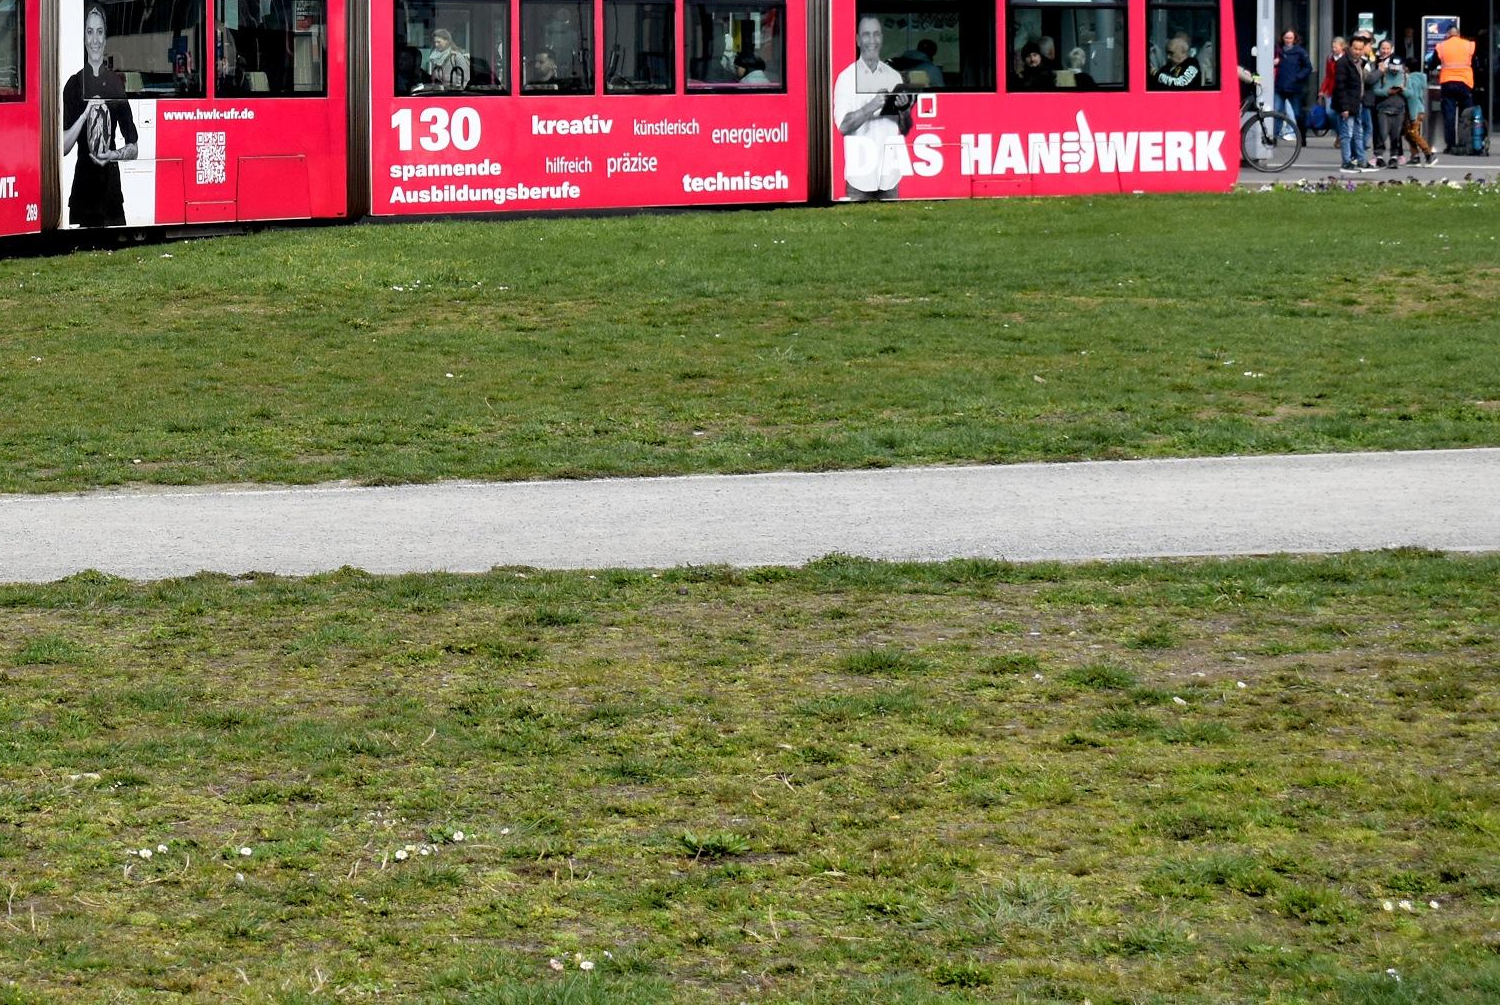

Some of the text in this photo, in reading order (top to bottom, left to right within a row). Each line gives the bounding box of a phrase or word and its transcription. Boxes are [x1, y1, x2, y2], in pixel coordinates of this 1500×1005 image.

[164, 108, 255, 121] www.hwk-ufr.de
[532, 114, 613, 135] kreativ
[391, 107, 481, 152] 130
[633, 118, 699, 135] künstlerisch
[712, 122, 788, 148] energievoll
[844, 110, 1227, 177] DAS HANDWERK
[390, 159, 501, 181] spannende
[546, 156, 592, 174] hilfreich
[607, 153, 657, 178] präzise
[683, 170, 788, 192] technisch
[389, 181, 580, 204] Ausbildungsberufe
[26, 204, 38, 222] 269
